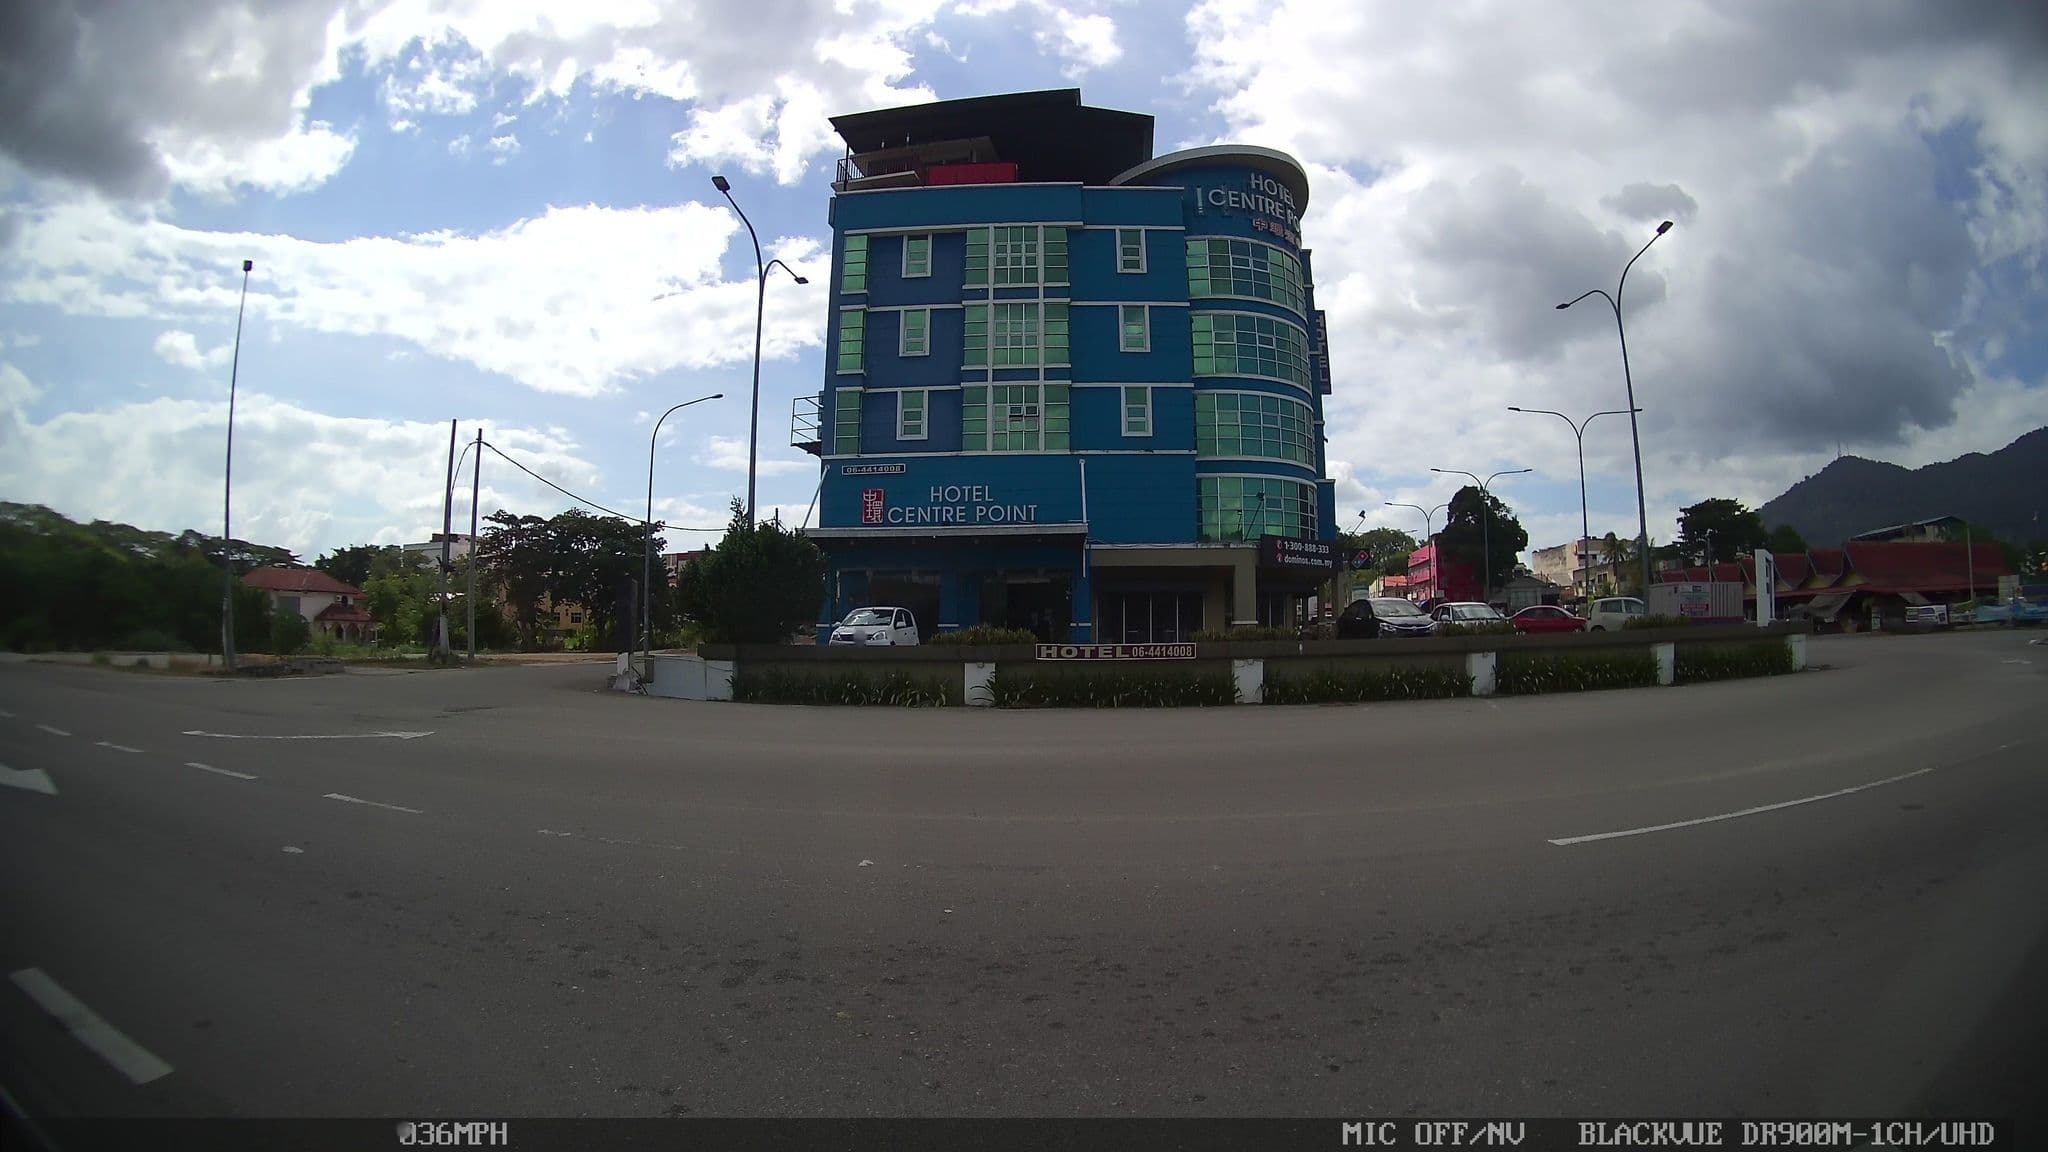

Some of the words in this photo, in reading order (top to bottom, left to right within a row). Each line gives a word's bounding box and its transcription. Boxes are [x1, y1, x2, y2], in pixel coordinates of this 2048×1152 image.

[1250, 172, 1296, 210] HOTEL
[1208, 188, 1284, 217] CENTRE
[846, 465, 901, 474] 06-4414008
[931, 485, 993, 503] HOTEL
[888, 506, 966, 524] CENTRE
[976, 504, 1037, 522] POINT
[1284, 541, 1329, 554] 1-300-888-333
[1284, 554, 1333, 568] dominos.com.my
[1040, 646, 1130, 658] HOTEL
[1132, 645, 1192, 657] 06-4414008
